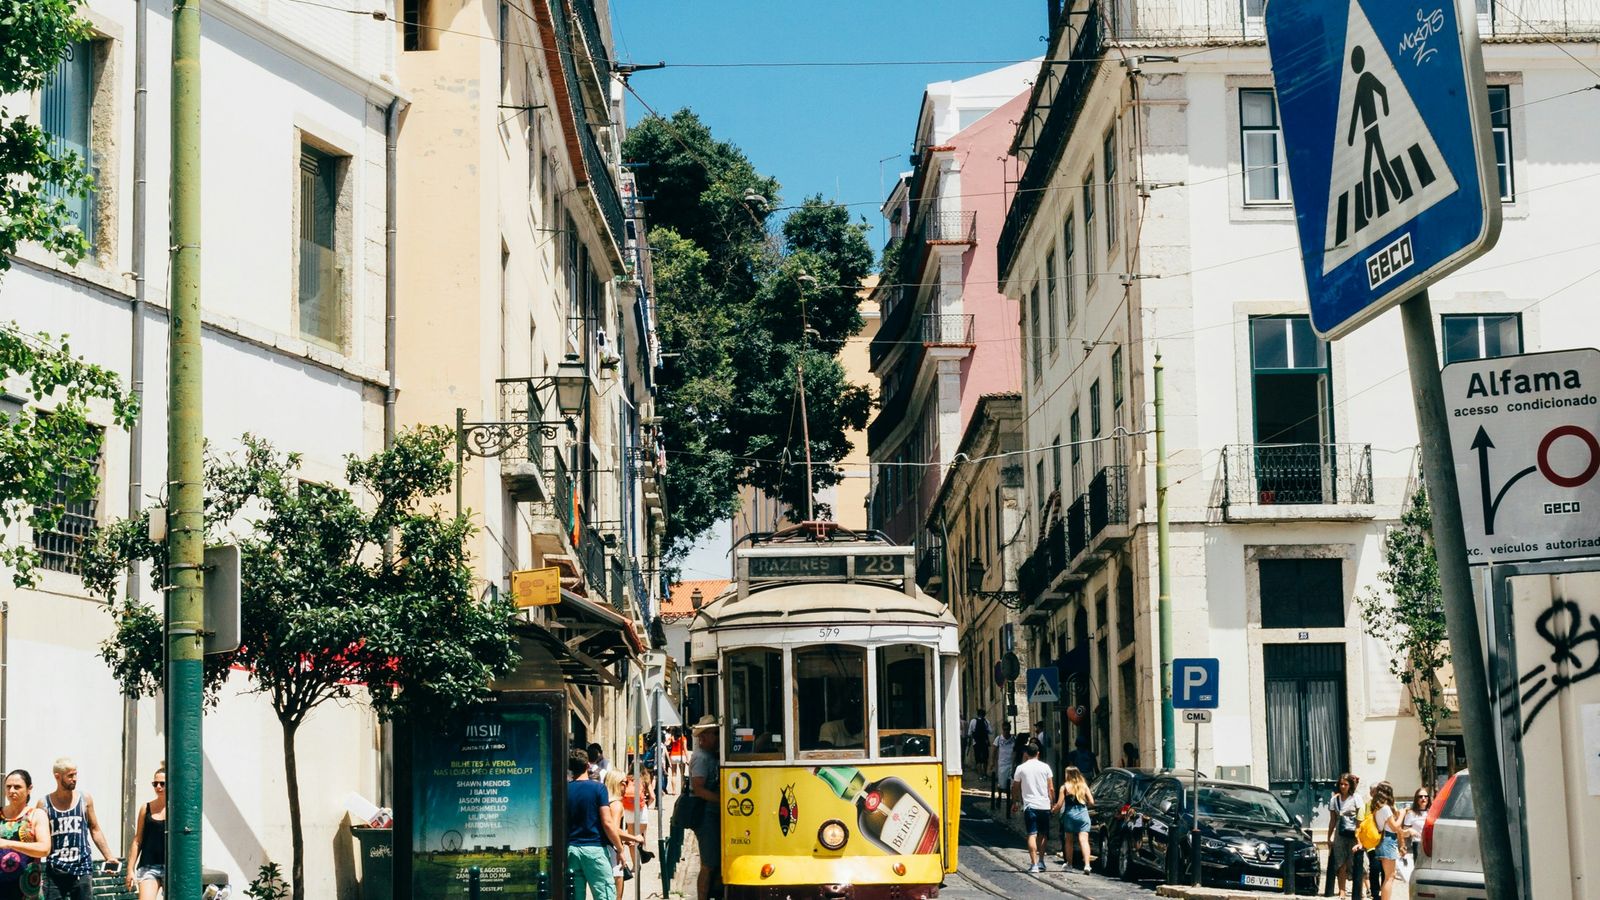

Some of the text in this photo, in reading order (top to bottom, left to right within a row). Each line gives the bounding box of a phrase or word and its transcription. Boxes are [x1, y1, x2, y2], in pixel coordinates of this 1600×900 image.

[1466, 369, 1581, 398] Alfama
[1454, 394, 1597, 417] acesso condicionado
[1490, 542, 1538, 554] veículos
[750, 557, 830, 571] PRAZERES
[865, 556, 895, 573] 28
[819, 628, 840, 638] 579
[1184, 666, 1208, 700] P
[507, 767, 533, 775] MEO.PT
[50, 816, 82, 836] LIKE
[63, 835, 69, 847] A
